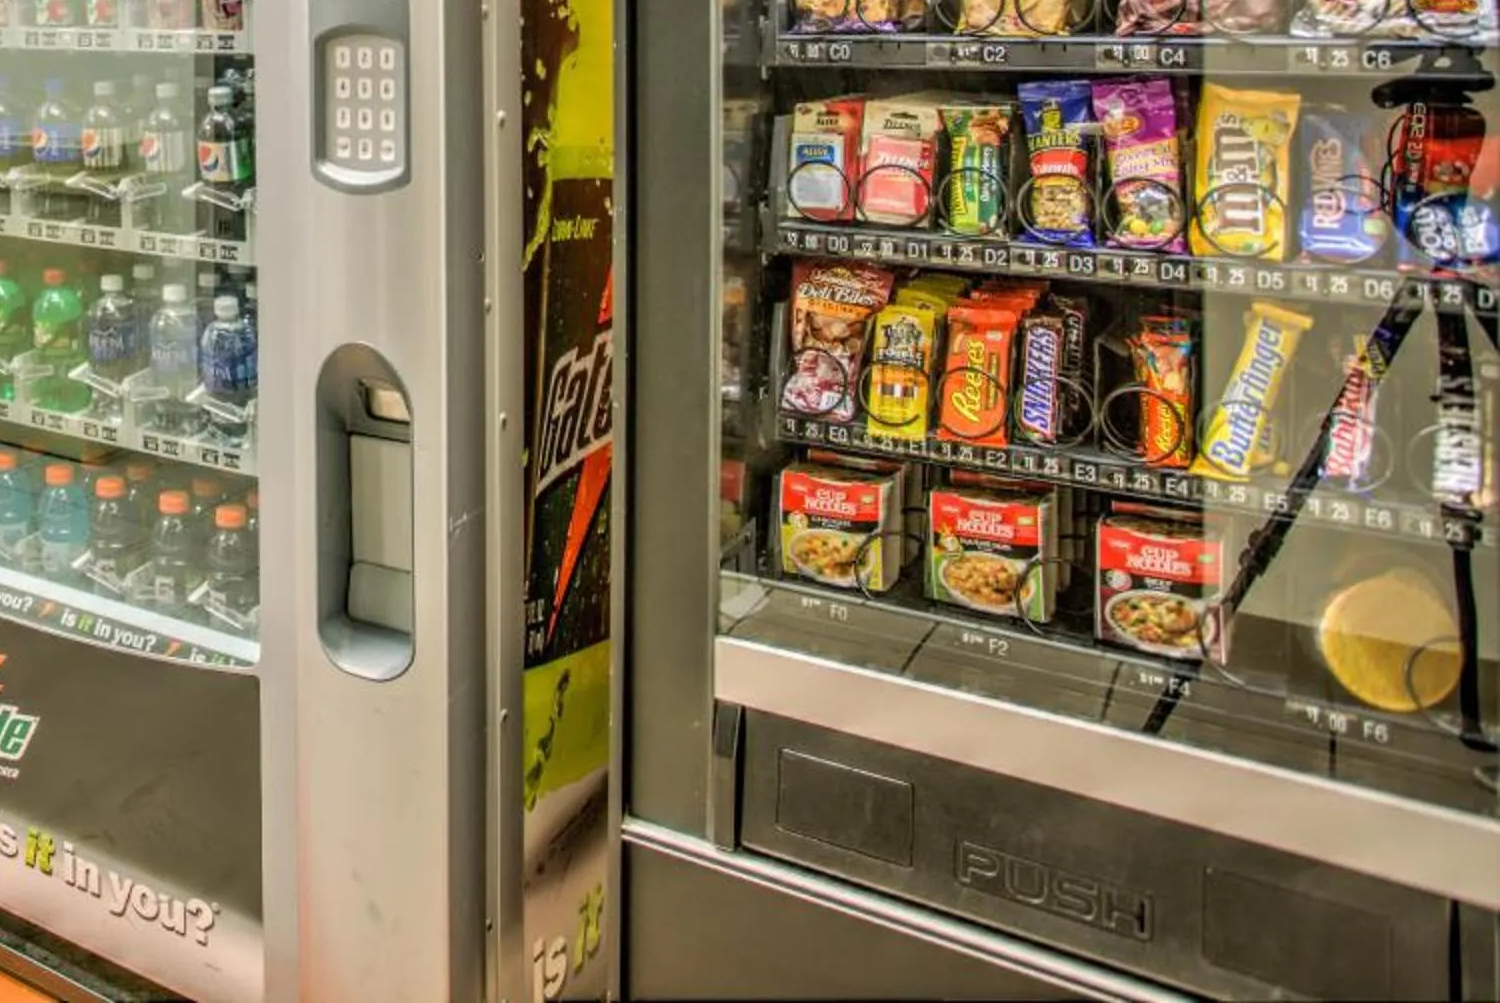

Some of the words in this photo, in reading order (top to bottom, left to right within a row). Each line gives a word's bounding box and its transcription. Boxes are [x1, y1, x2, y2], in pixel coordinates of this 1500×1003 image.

[829, 44, 850, 60] C0
[984, 47, 1006, 62] C2
[1161, 49, 1186, 65] C4
[1363, 50, 1391, 69] C6
[828, 236, 849, 252] D0
[908, 243, 928, 260] D1
[985, 249, 1008, 266] D2
[1070, 255, 1094, 273] D3
[1161, 263, 1187, 281] D4
[1258, 271, 1284, 290] D5
[1364, 280, 1394, 299] D6
[1211, 318, 1284, 469] Butterfinger
[829, 426, 848, 442] E0
[986, 450, 1007, 466] E2
[1075, 464, 1096, 482] E3
[1166, 479, 1189, 495] E4
[803, 495, 857, 516] NOODLES
[1264, 494, 1289, 512] E5
[1365, 508, 1393, 528] E6
[956, 518, 1015, 539] NOODLES
[1141, 545, 1180, 561] CUP
[1127, 554, 1193, 576] NOODLES
[831, 605, 847, 621] F0
[61, 607, 77, 627] is
[77, 613, 95, 633] it
[93, 619, 111, 639] in
[113, 627, 157, 653] you?
[988, 638, 1008, 656] F2
[1169, 678, 1191, 696] F4
[1364, 723, 1388, 743] F6
[24, 826, 56, 876] it
[63, 843, 102, 898] in
[107, 871, 218, 947] you?
[961, 840, 1151, 939] PUSH
[573, 882, 605, 977] it
